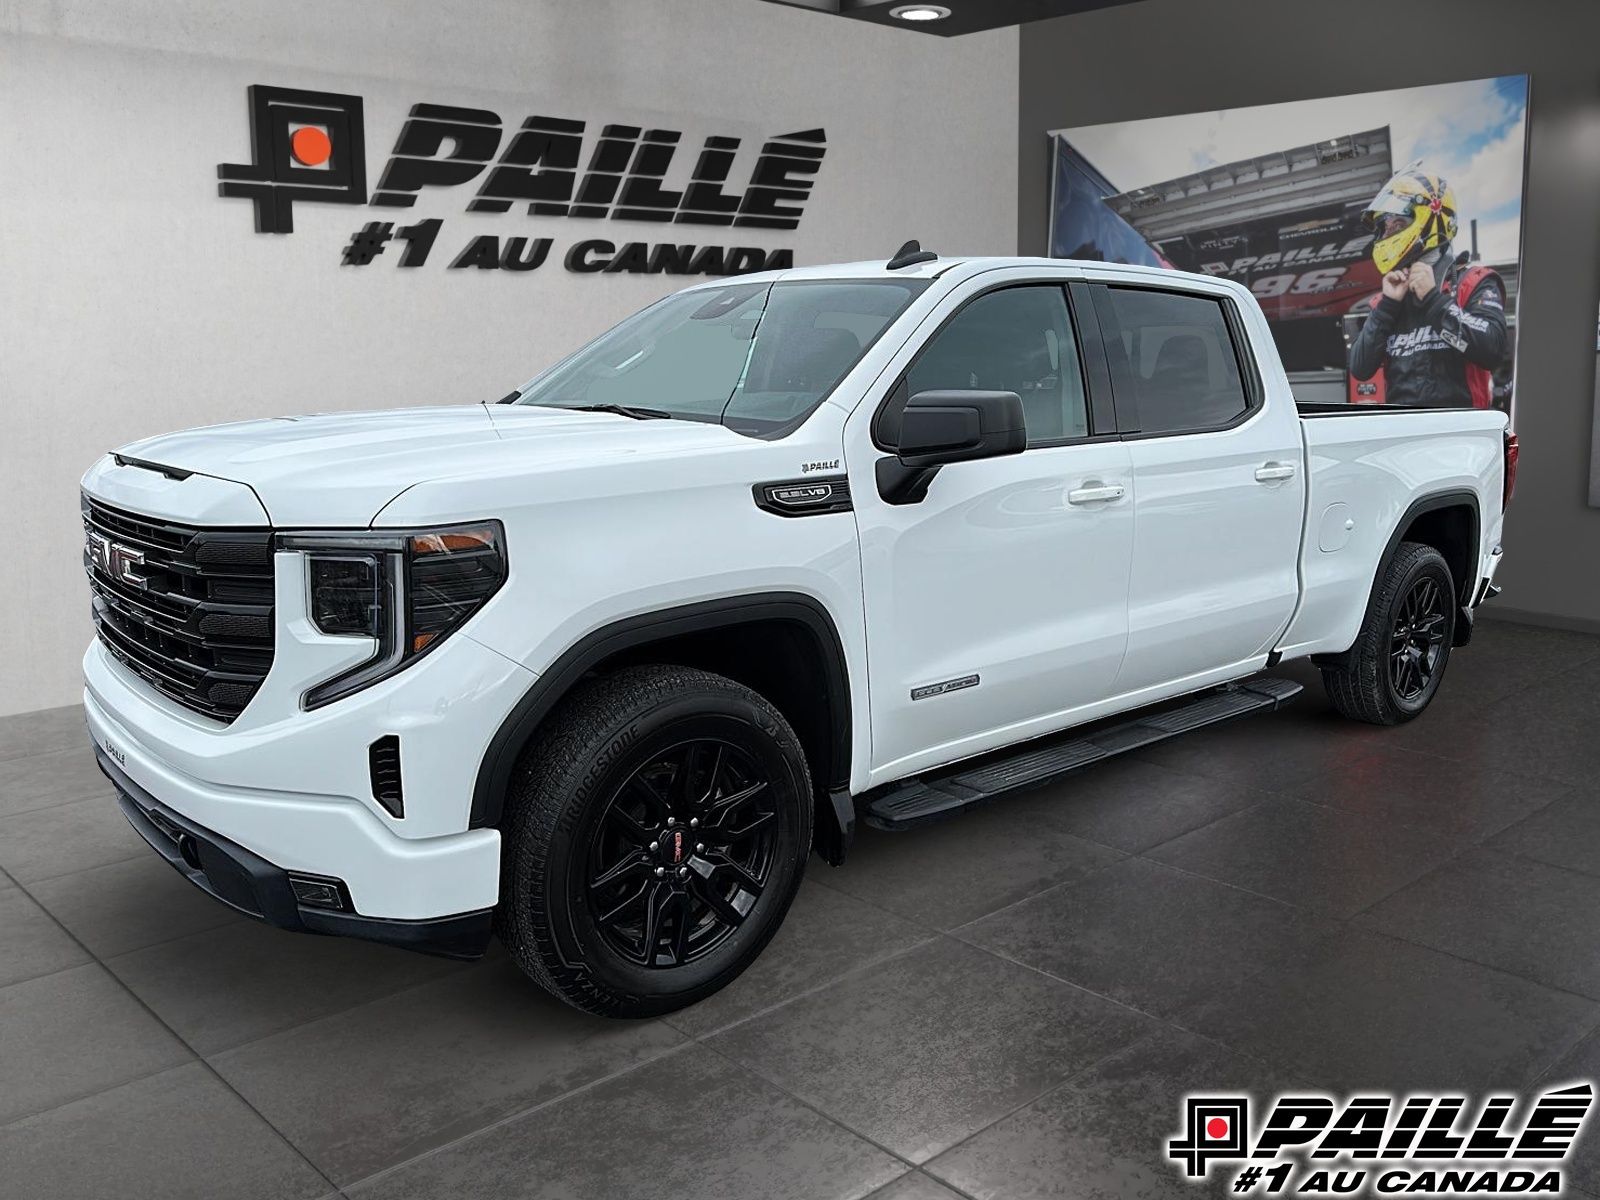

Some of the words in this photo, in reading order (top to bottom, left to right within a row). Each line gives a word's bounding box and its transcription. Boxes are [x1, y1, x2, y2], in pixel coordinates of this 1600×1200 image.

[369, 102, 827, 229] PAILLÉ
[341, 218, 444, 268] #1
[447, 235, 554, 271] AU
[564, 238, 795, 276] CANADA
[1251, 267, 1348, 299] 96
